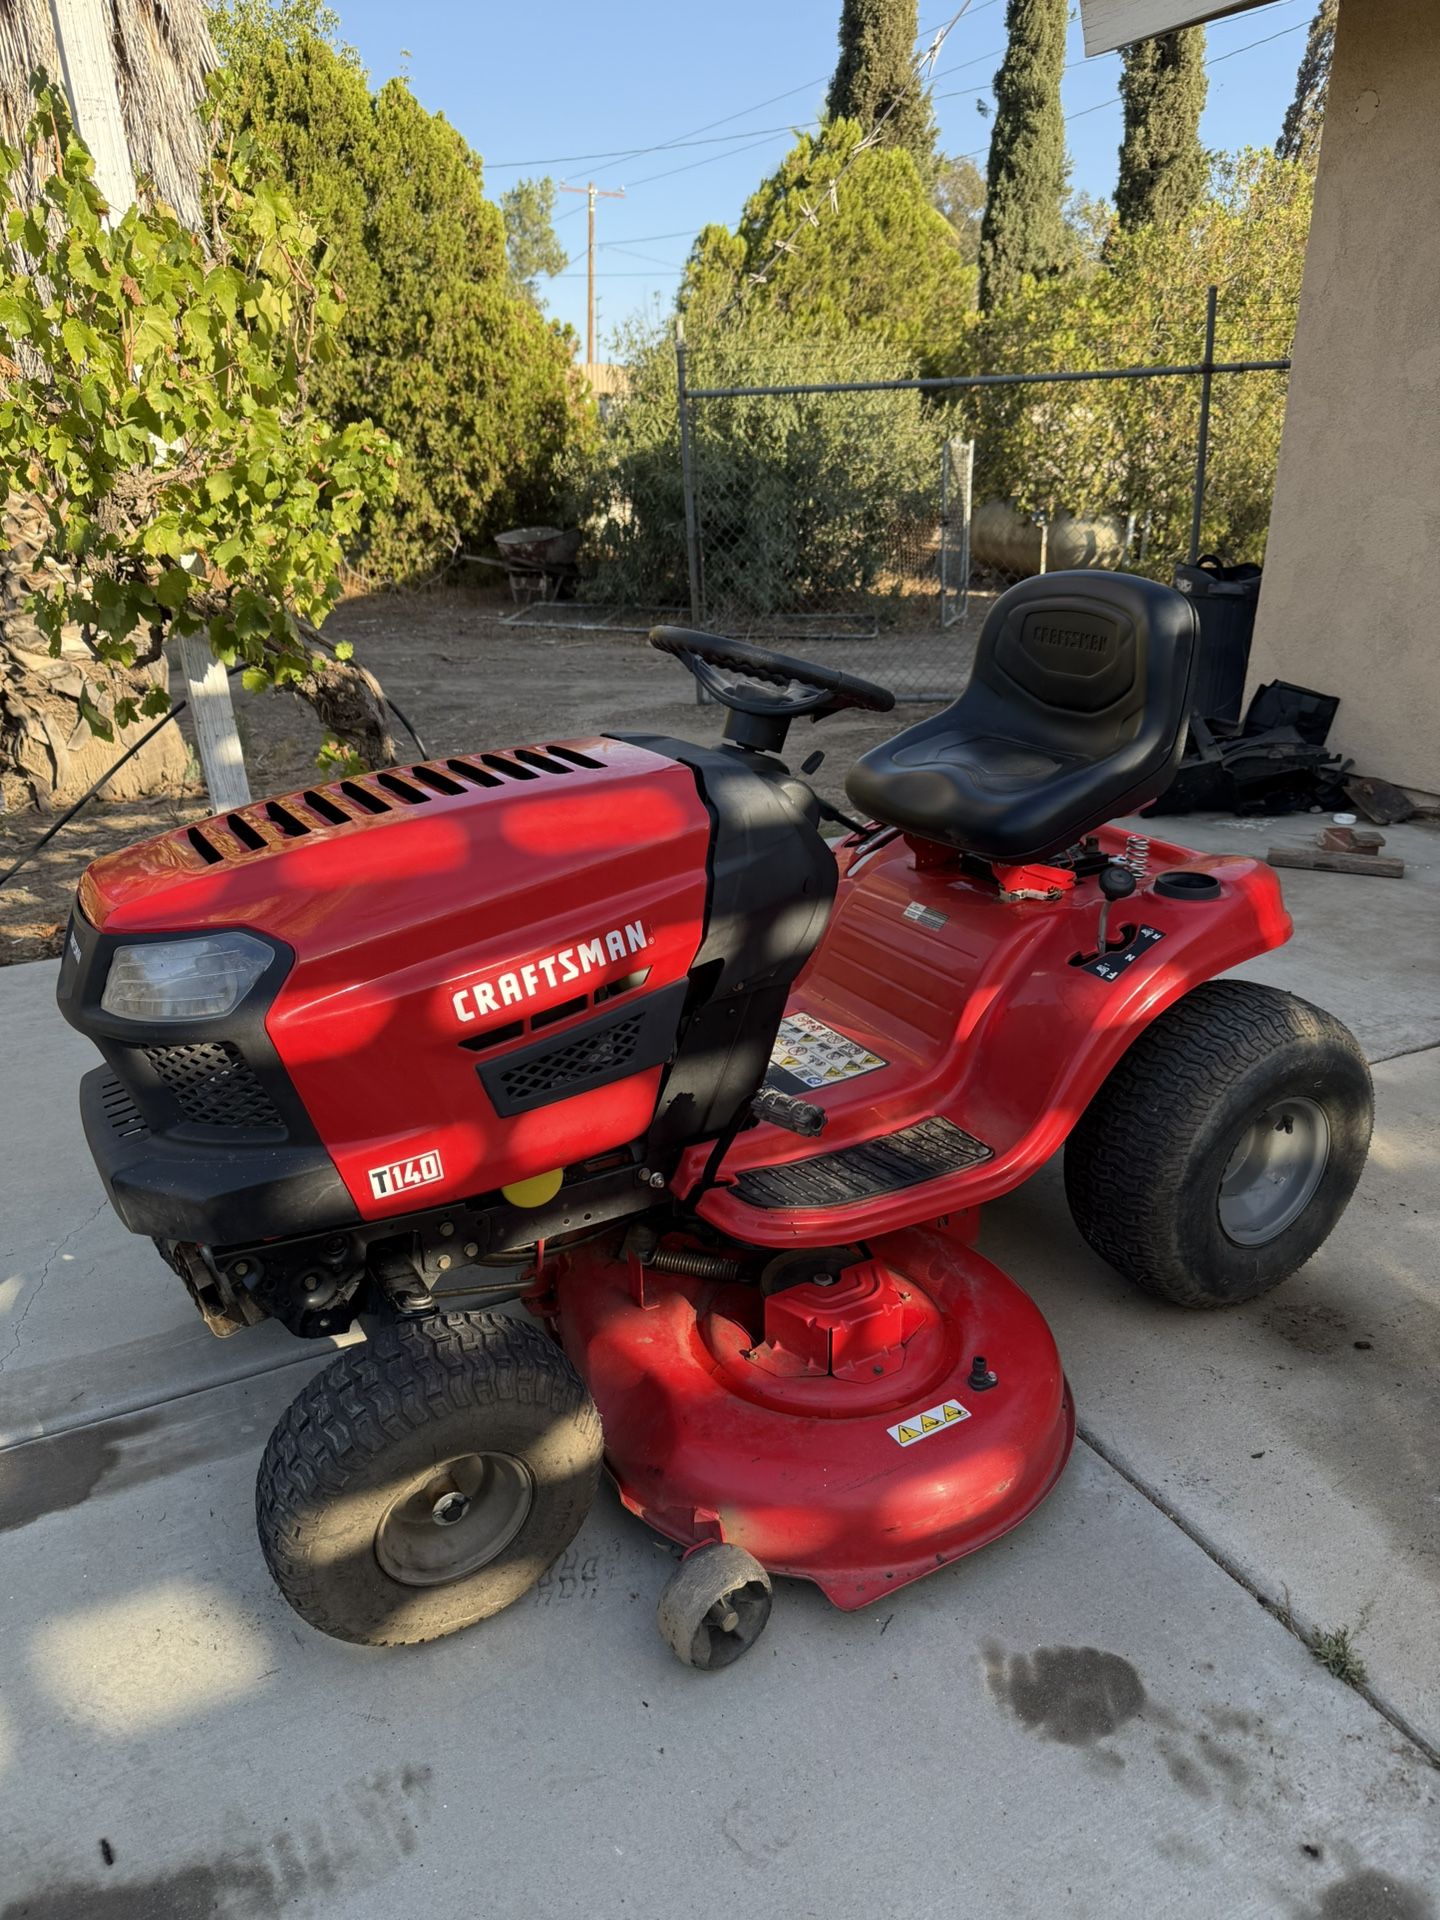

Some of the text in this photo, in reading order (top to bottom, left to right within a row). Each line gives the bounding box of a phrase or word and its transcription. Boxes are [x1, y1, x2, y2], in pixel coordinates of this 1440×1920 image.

[1124, 953, 1136, 962] N
[452, 920, 648, 1022] CRAFTSMAN
[1106, 971, 1118, 980] F
[371, 1154, 439, 1194] T140
